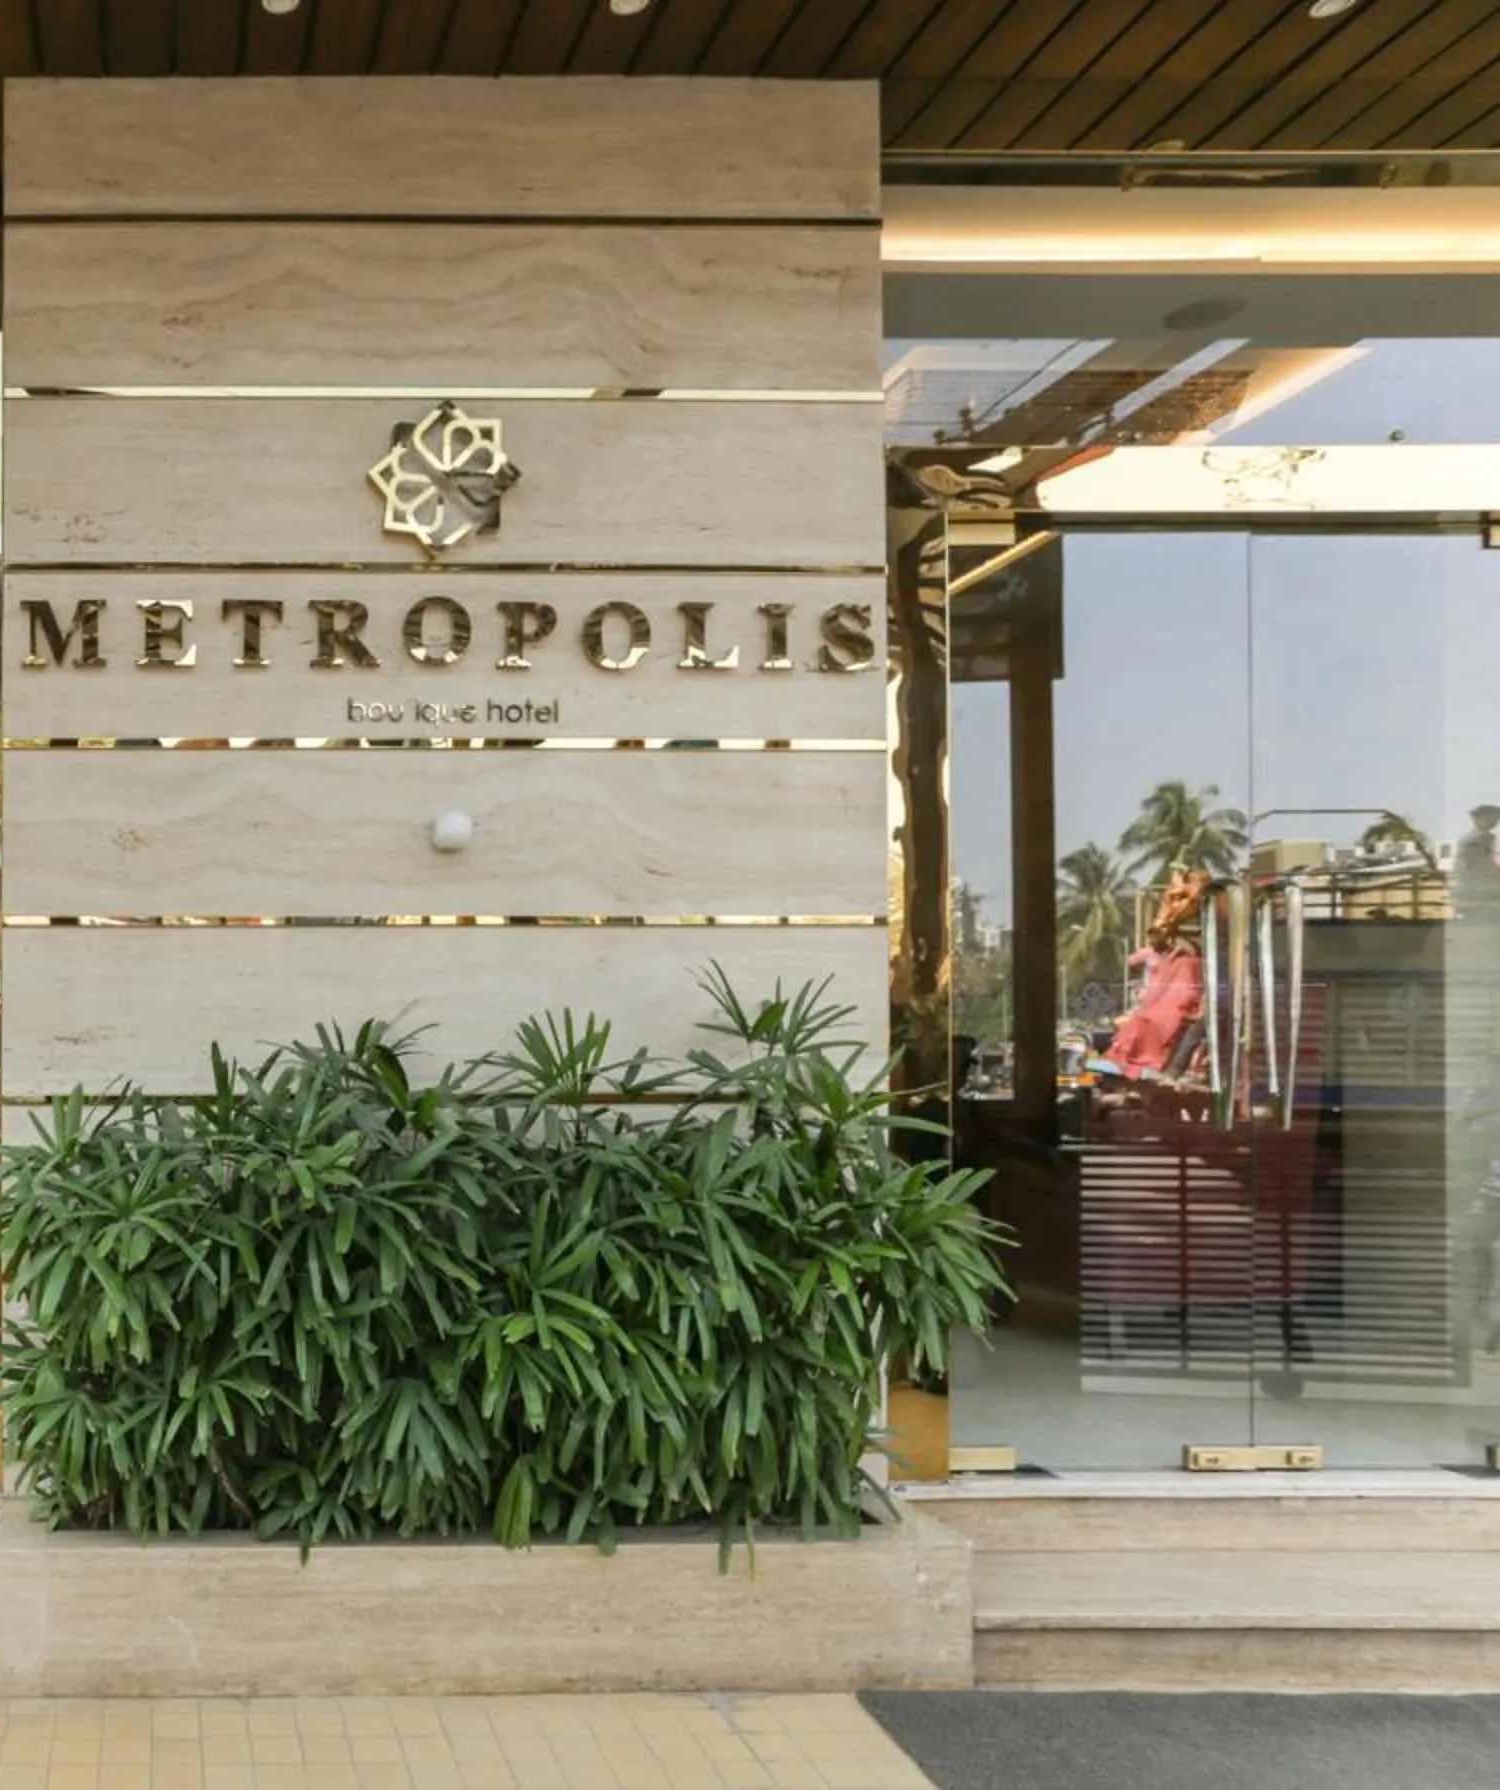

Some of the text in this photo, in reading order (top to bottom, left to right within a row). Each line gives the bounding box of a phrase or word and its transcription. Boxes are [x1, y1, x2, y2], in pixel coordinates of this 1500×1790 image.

[19, 595, 877, 672] METROPOLIS
[346, 696, 560, 726] bouique hotel
